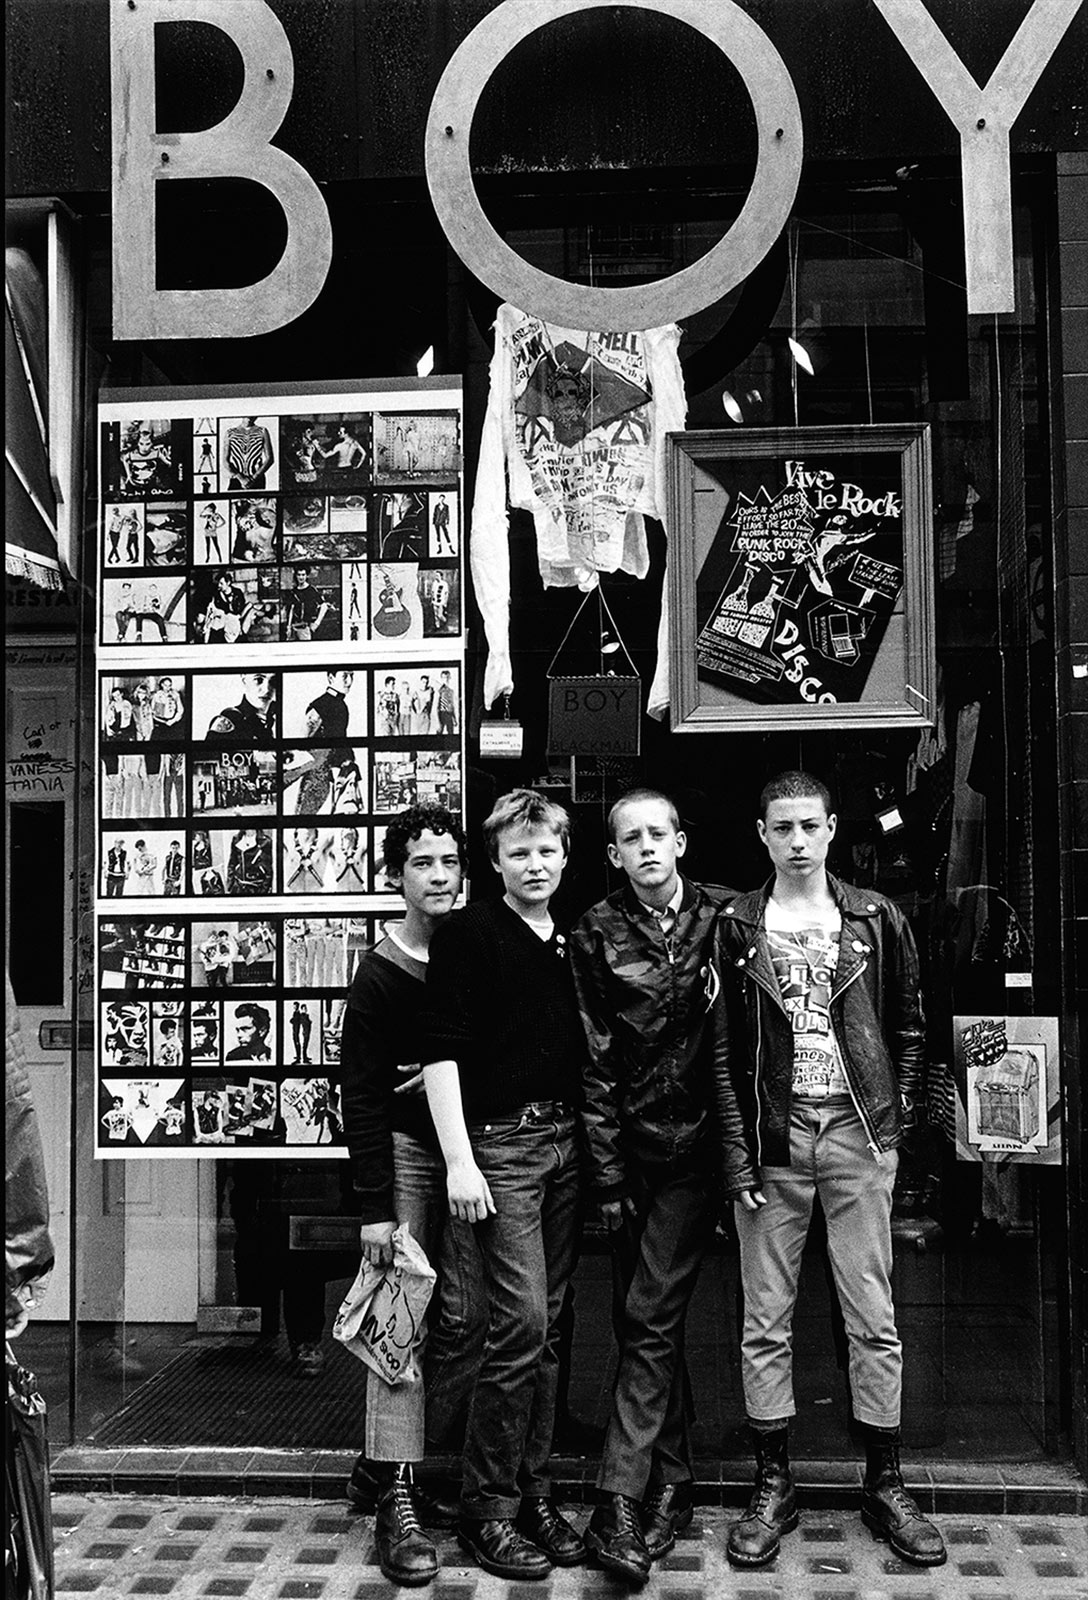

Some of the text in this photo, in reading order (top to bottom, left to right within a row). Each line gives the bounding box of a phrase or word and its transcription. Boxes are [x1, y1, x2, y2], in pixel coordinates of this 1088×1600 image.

[110, 0, 1086, 341] BOY
[598, 332, 639, 356] HELL
[784, 460, 835, 490] Vive
[814, 482, 903, 518] le Rock
[737, 513, 768, 524] EFFORT
[779, 508, 794, 519] FAR
[780, 518, 797, 530] 20
[737, 537, 806, 552] PUNK ROCK
[748, 550, 786, 562] DISCO
[564, 689, 628, 712] BOY
[222, 752, 253, 767] BOY
[788, 1012, 827, 1030] OLS
